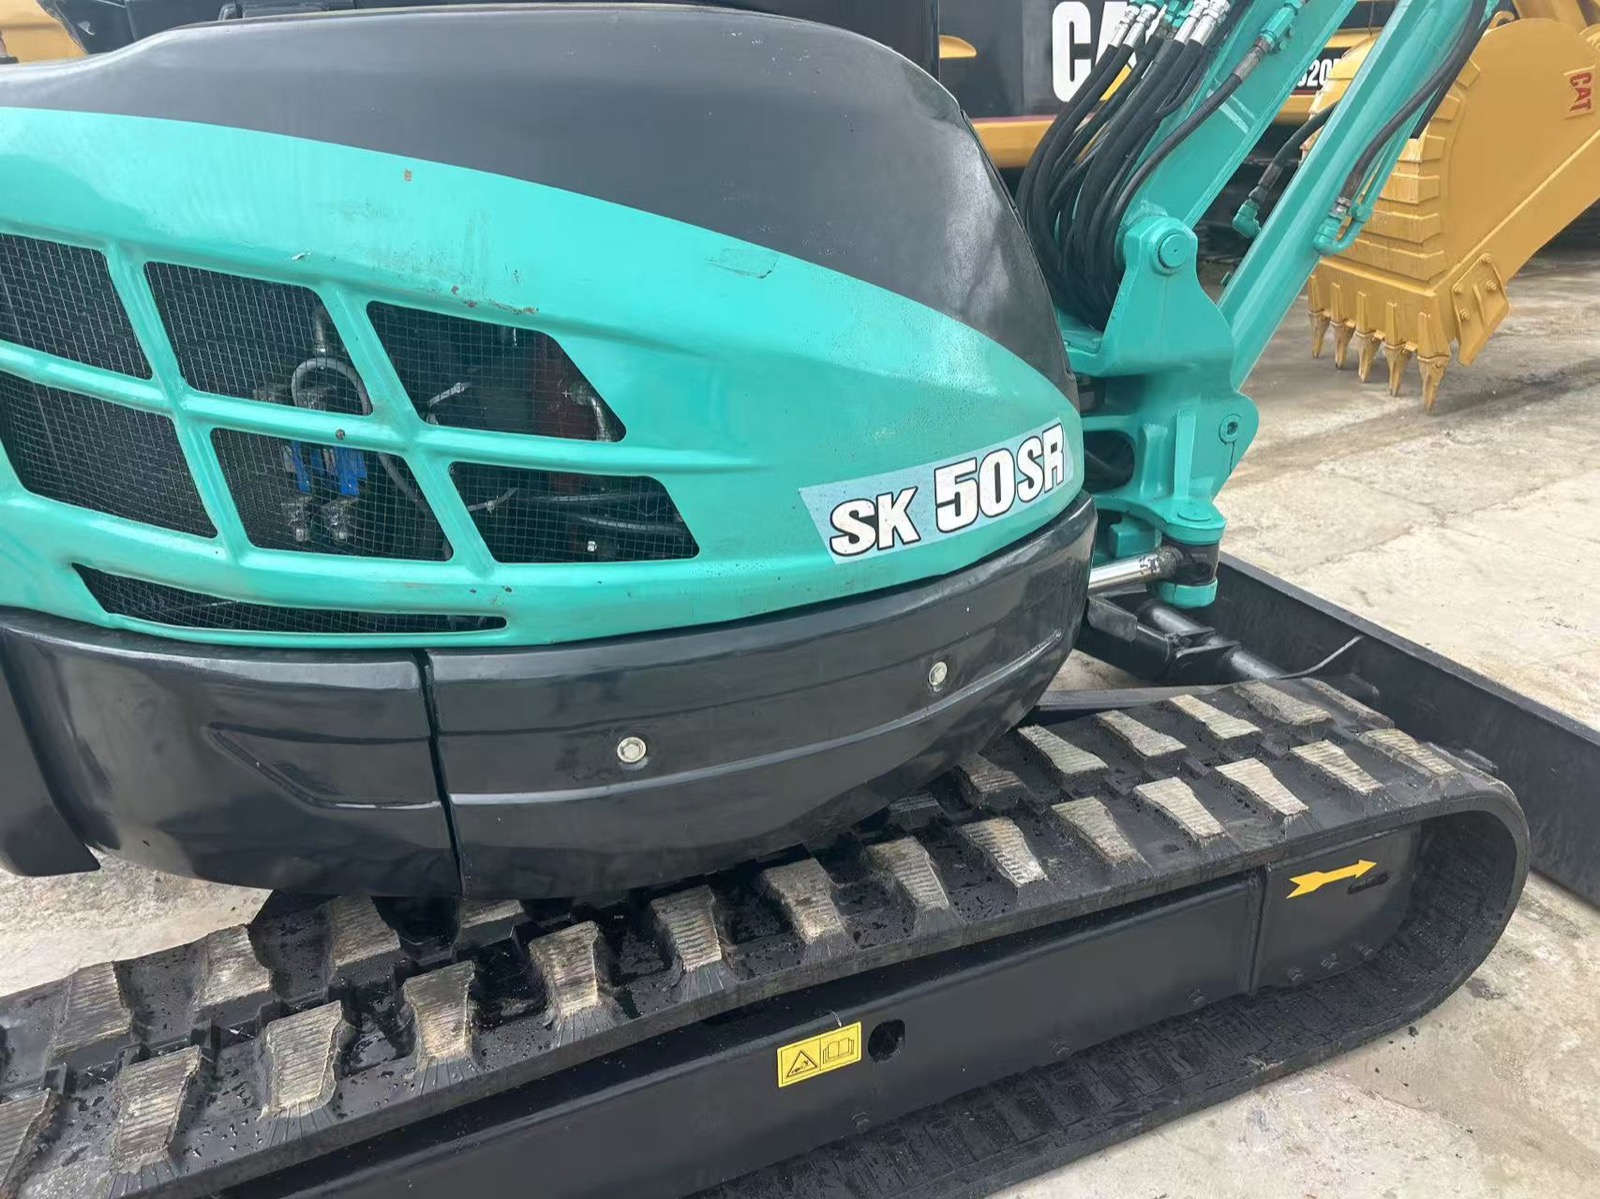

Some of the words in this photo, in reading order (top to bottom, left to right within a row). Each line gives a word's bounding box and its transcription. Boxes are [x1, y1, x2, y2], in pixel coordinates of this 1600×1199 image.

[1569, 72, 1592, 112] CAT
[829, 486, 921, 557] SK
[933, 422, 1065, 533] 50SR
